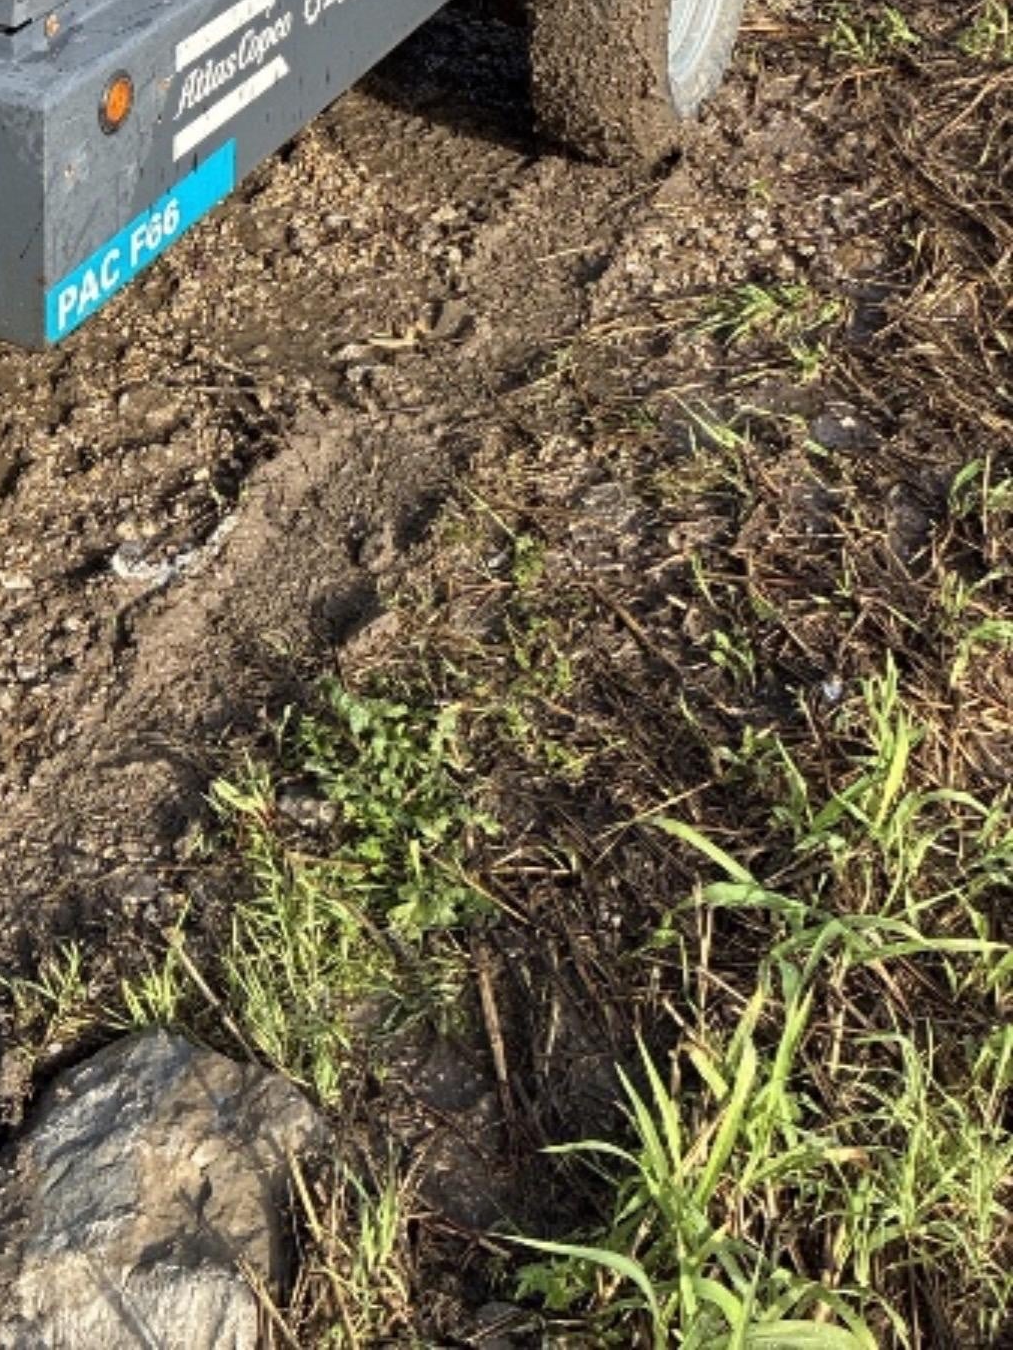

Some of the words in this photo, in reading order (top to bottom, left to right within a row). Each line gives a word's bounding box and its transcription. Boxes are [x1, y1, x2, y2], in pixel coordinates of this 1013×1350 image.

[173, 52, 237, 120] Atlas
[238, 11, 292, 70] Copco
[58, 247, 120, 331] PAC
[130, 197, 180, 268] F66
